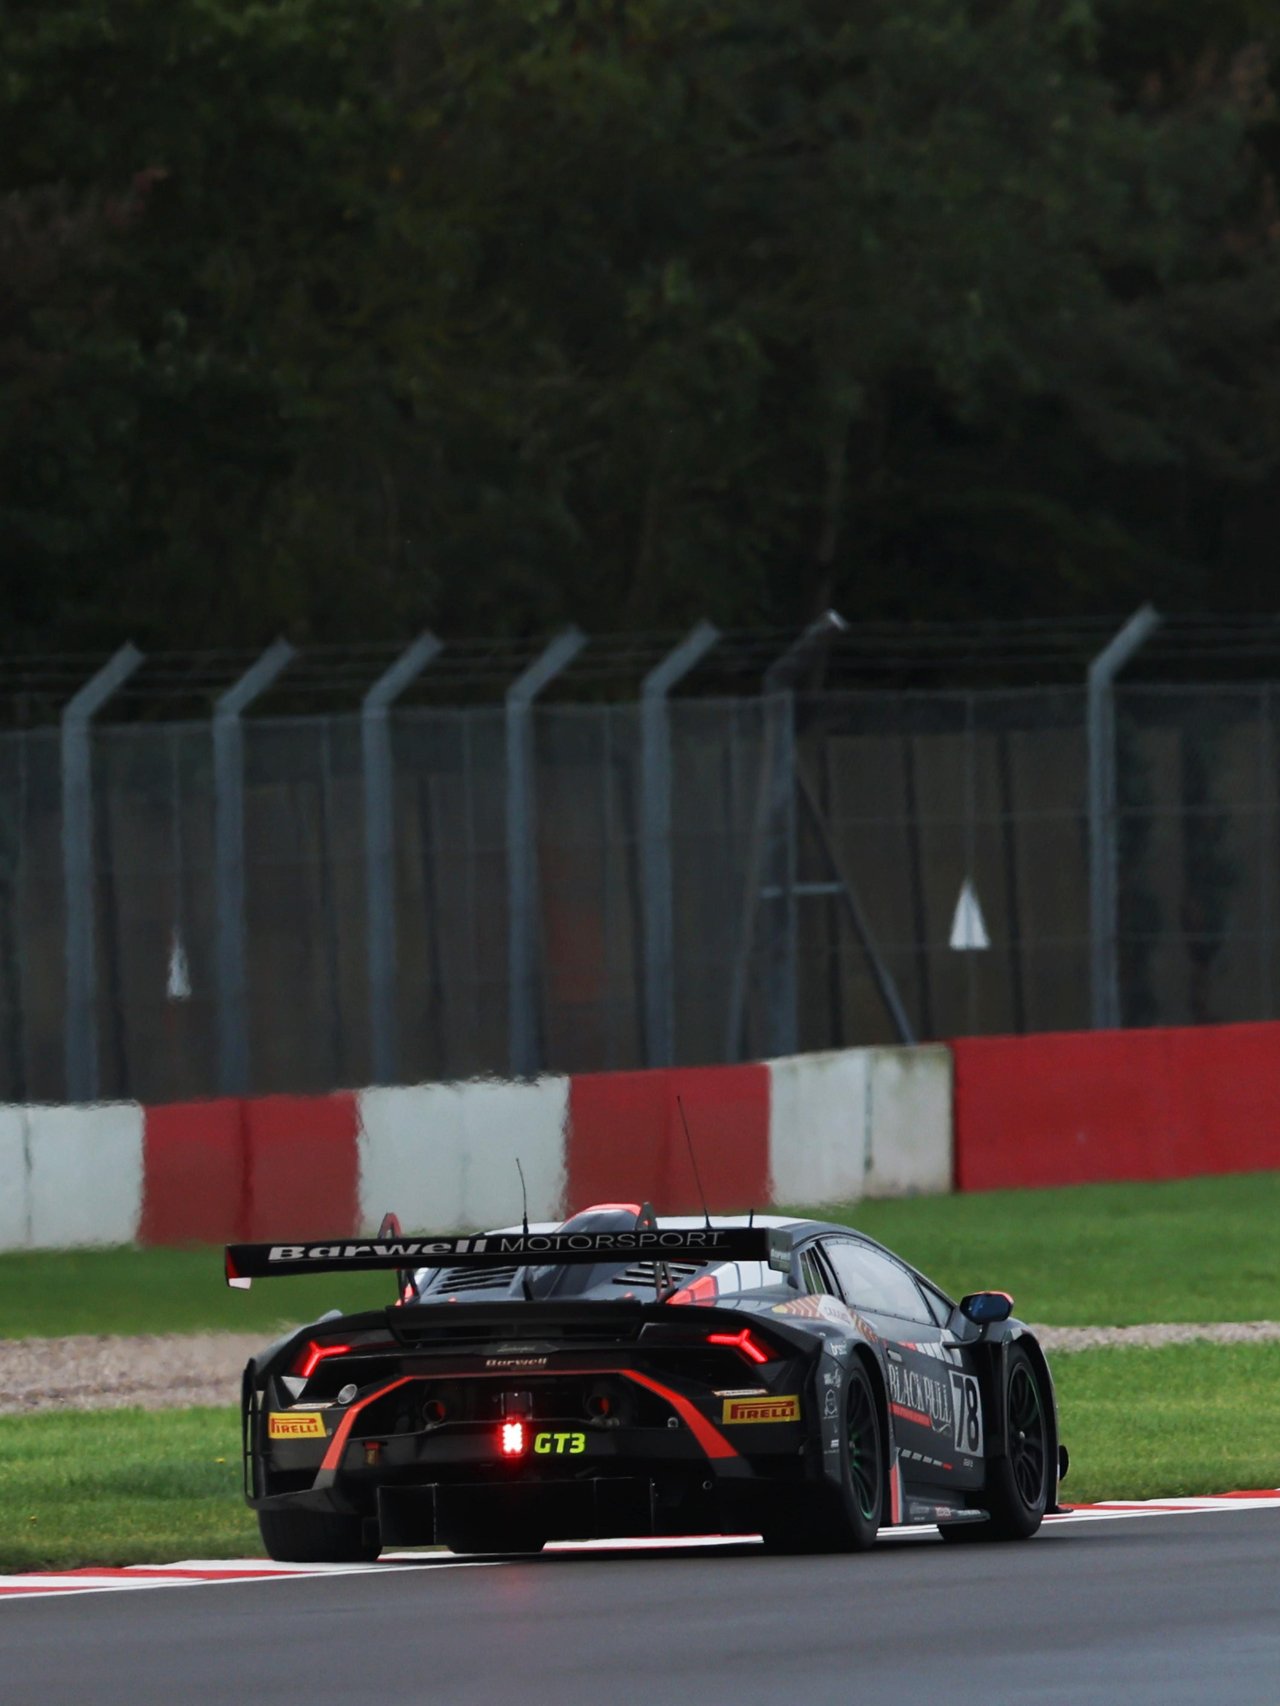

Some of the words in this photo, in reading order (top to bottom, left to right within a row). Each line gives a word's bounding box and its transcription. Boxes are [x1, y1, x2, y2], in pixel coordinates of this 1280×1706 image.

[268, 1239, 487, 1261] Barwell
[500, 1231, 725, 1252] MOTORSPORT
[730, 1401, 795, 1419] PIRELLI
[951, 1372, 980, 1452] 78
[271, 1418, 318, 1433] PIRELLI
[535, 1433, 585, 1453] GT3
